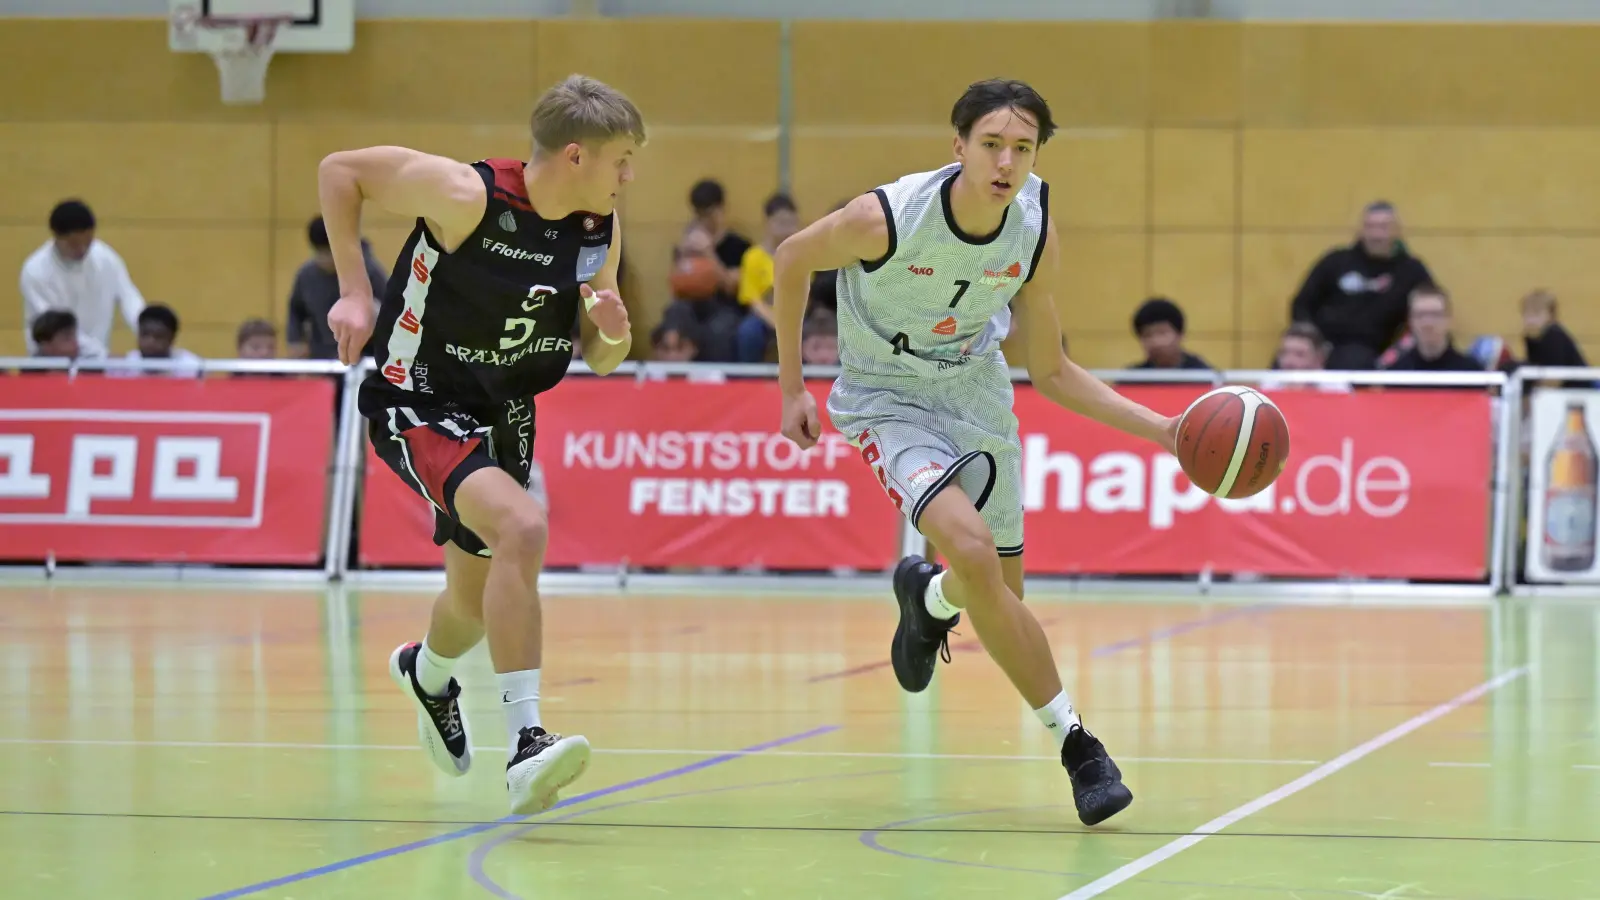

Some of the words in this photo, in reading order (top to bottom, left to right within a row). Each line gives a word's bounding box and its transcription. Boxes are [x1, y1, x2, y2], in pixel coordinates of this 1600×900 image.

[544, 228, 559, 240] 43
[907, 264, 935, 277] JAKO
[948, 279, 971, 309] 7
[628, 477, 850, 517] FENSTER
